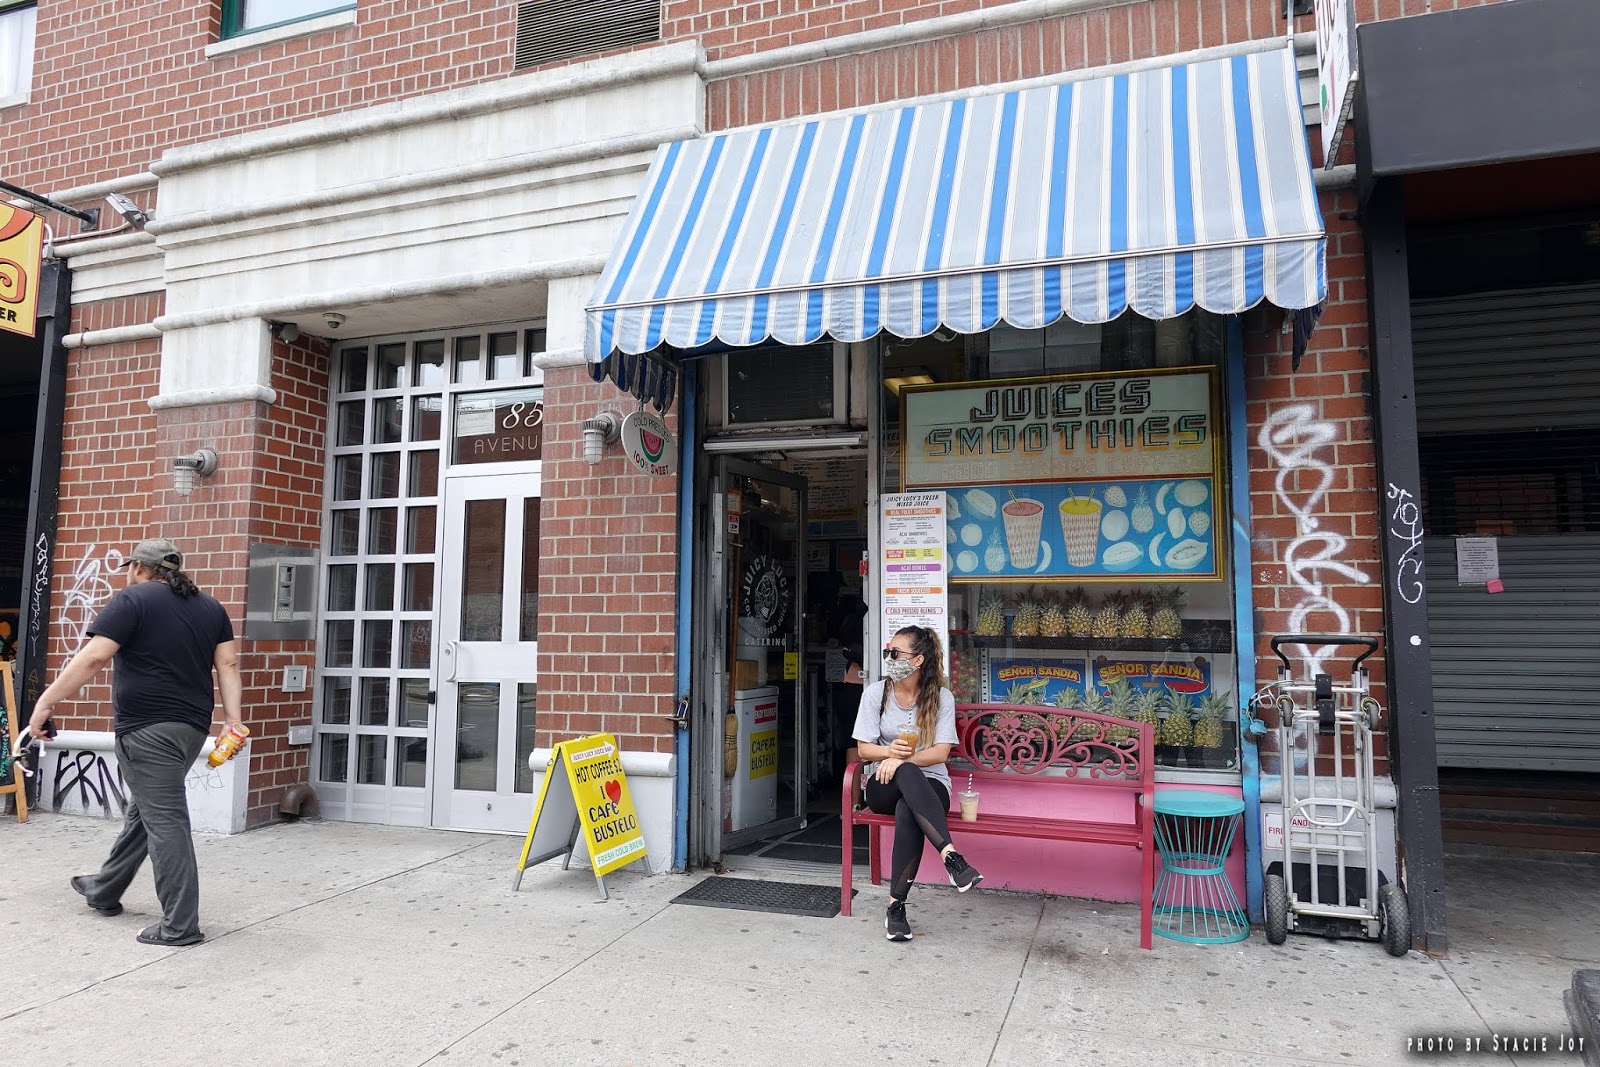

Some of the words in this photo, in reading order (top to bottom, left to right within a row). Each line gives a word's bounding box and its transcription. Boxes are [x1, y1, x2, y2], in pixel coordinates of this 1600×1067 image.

[970, 379, 1151, 423] JUICES
[927, 414, 1206, 458] SMOOTHIES
[633, 450, 649, 471] 100%
[651, 464, 669, 475] SWEET
[743, 555, 767, 596] JUICY
[771, 558, 789, 599] LUCY
[744, 637, 787, 646] CATERING
[574, 765, 591, 784] HOT
[590, 759, 614, 779] COFFEE
[613, 757, 622, 776] $2
[600, 785, 606, 799] I
[593, 814, 637, 843] BUSTELO
[597, 851, 615, 865] FRESH
[615, 845, 629, 857] COLD
[629, 838, 644, 851] BREW
